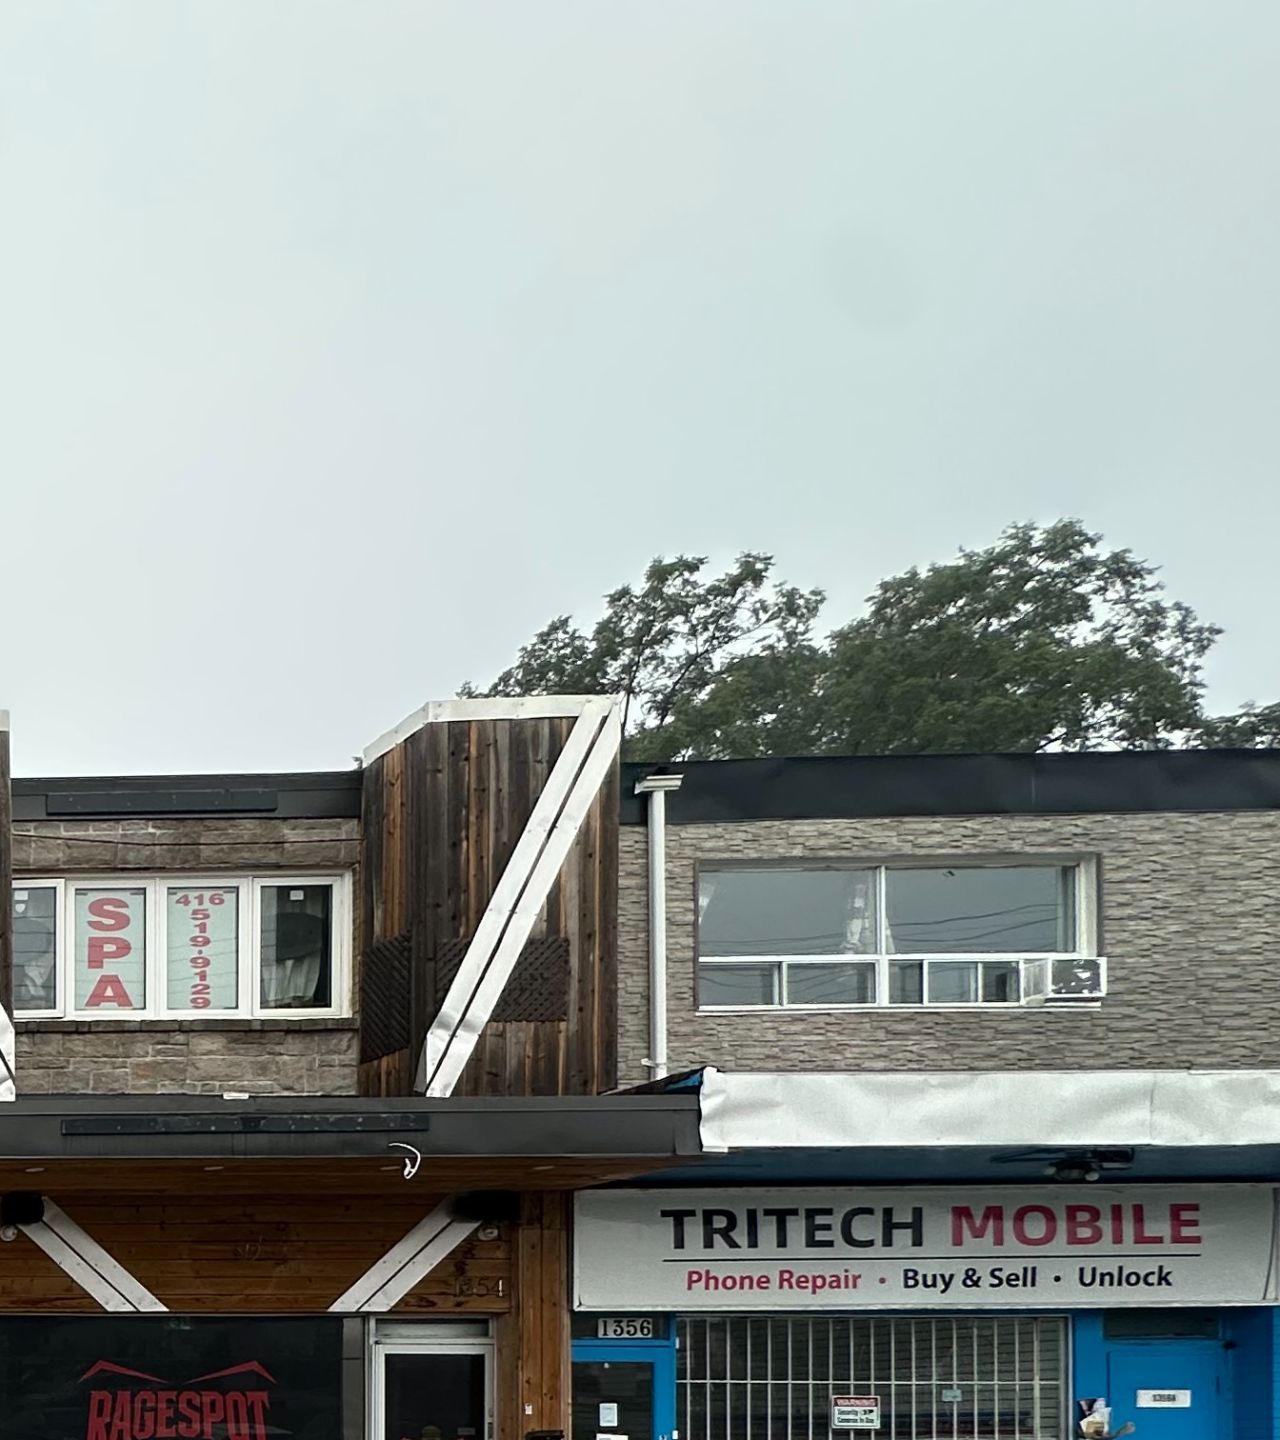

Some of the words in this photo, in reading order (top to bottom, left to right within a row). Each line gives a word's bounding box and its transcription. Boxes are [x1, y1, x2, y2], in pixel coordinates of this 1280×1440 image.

[175, 893, 225, 907] 416
[85, 897, 133, 1008] SPA
[660, 1207, 923, 1250] TRITECH
[951, 1203, 1202, 1247] MOBILE
[687, 1269, 770, 1291] Phone
[779, 1269, 862, 1295] Repair
[903, 1268, 955, 1294] Buy
[962, 1268, 982, 1288] &
[989, 1266, 1037, 1288] Sell
[1078, 1265, 1173, 1288] Unlock
[600, 1319, 651, 1337] 1356
